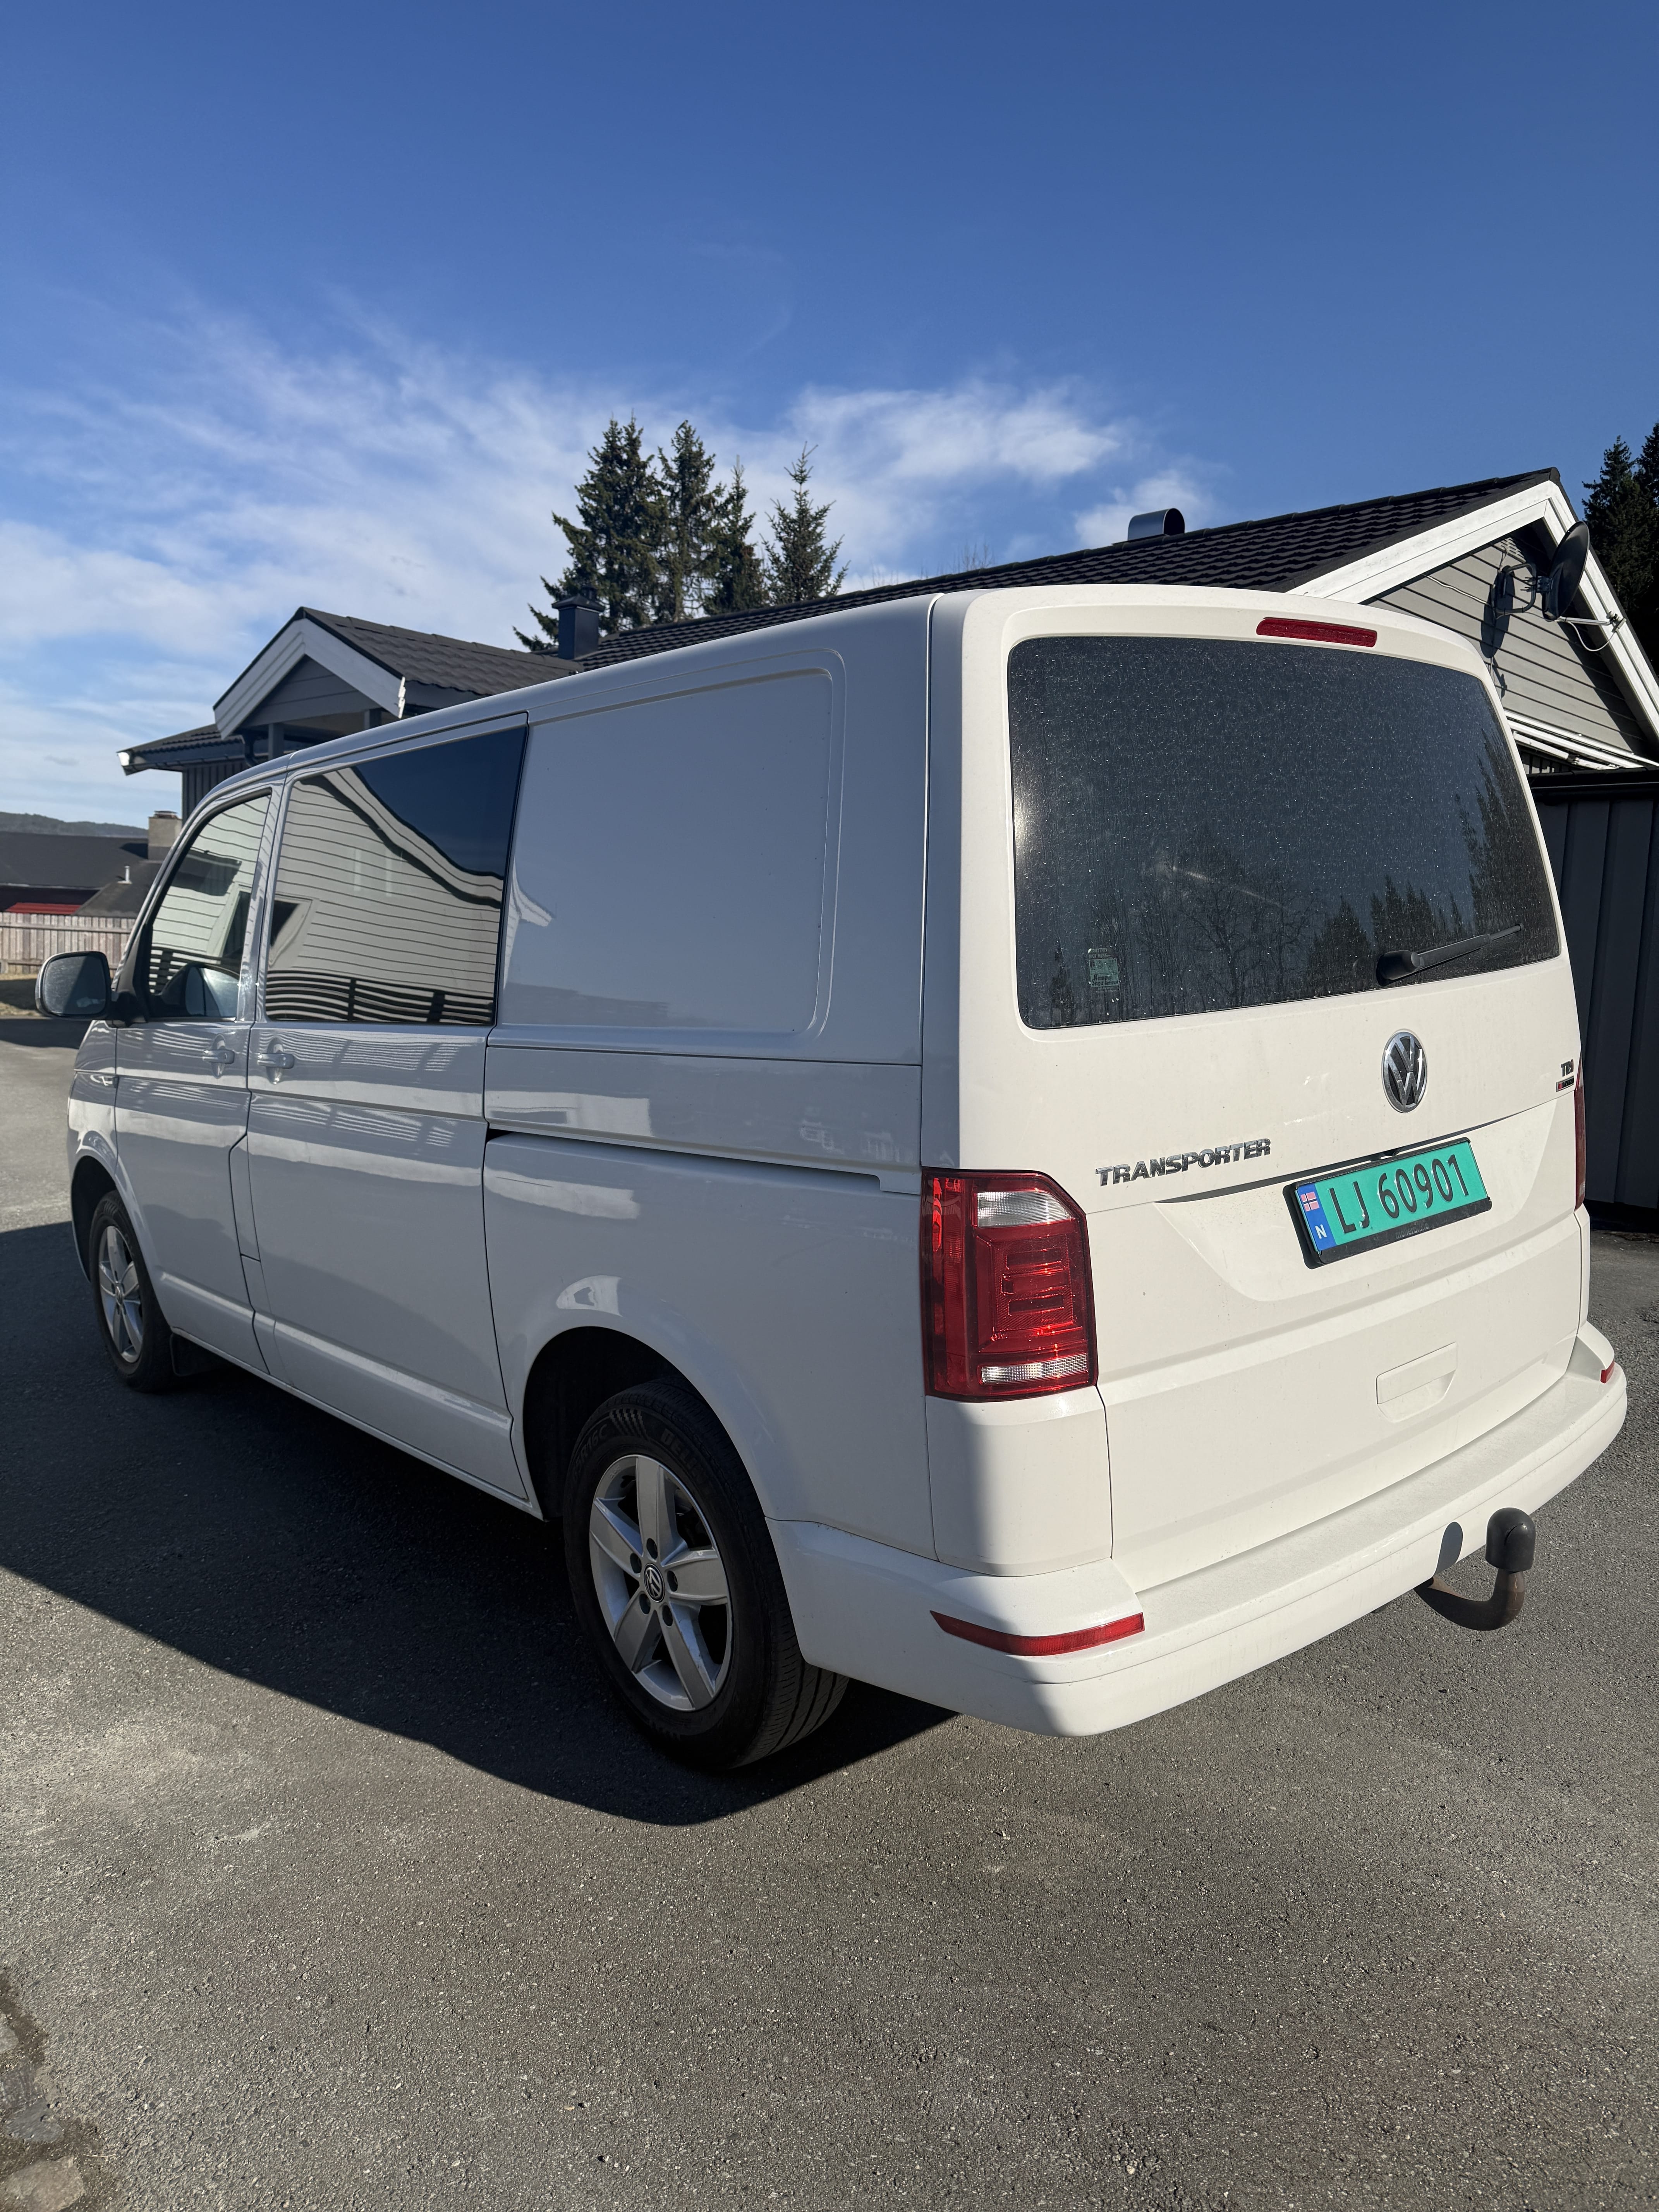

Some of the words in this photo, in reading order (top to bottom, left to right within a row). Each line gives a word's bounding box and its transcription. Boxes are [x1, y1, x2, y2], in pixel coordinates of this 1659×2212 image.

[1095, 1138, 1271, 1187] TRANSPORTER
[1329, 1181, 1370, 1233] LJ
[1377, 1154, 1469, 1219] 60901
[1315, 1224, 1328, 1240] N
